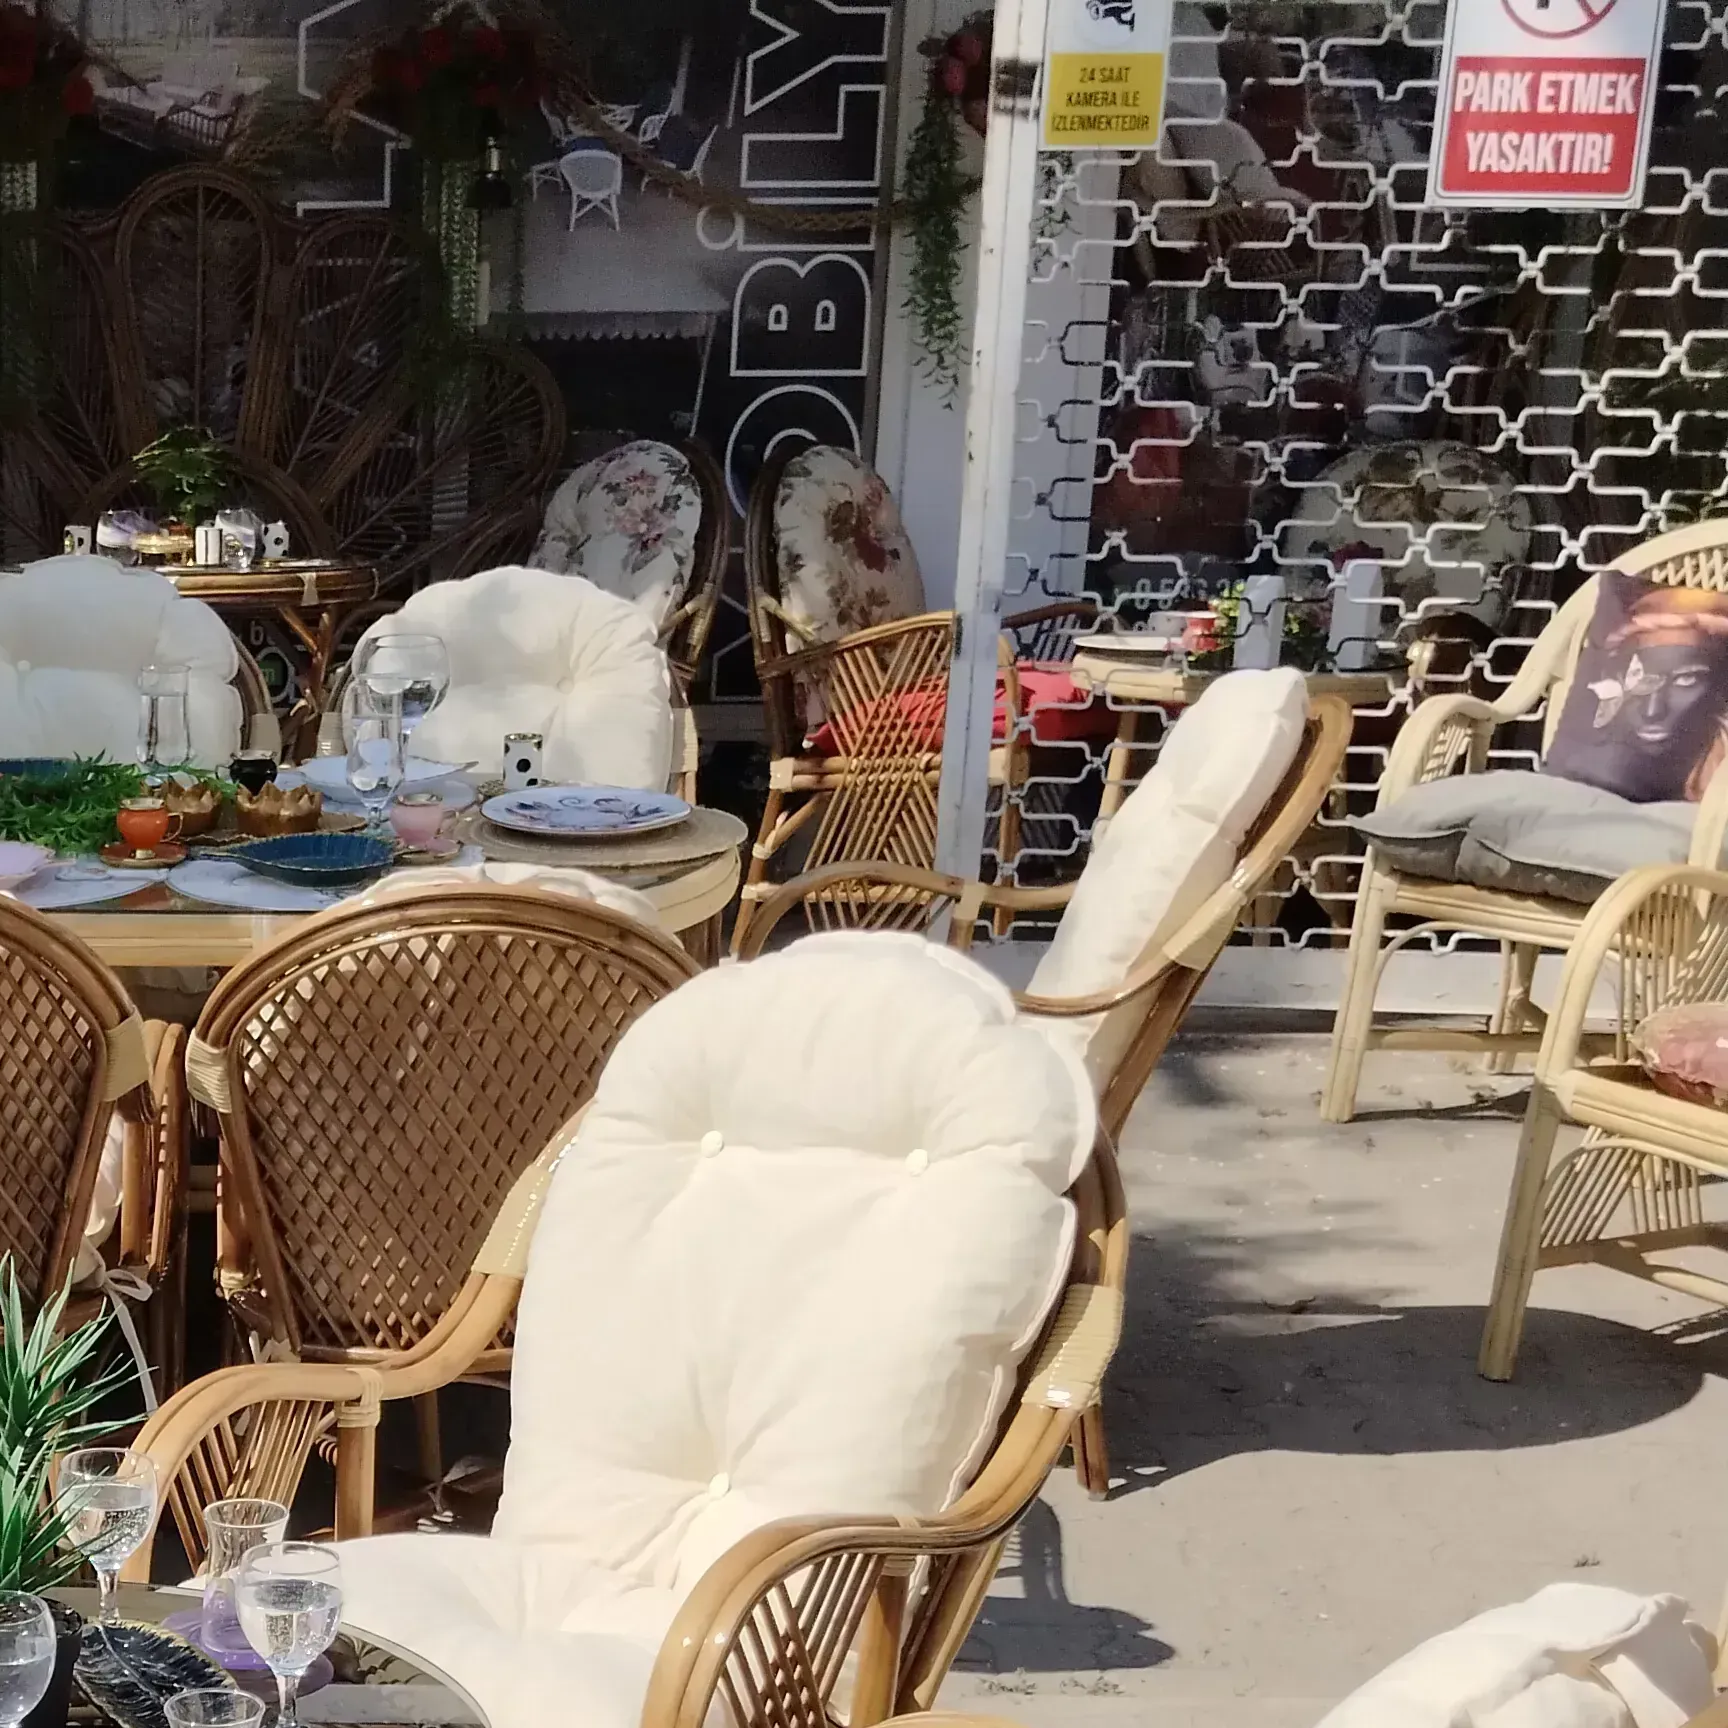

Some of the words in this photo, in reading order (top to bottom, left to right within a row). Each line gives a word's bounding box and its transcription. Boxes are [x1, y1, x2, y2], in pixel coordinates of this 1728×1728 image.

[1079, 66, 1096, 83] 24
[1098, 66, 1131, 83] SAAT
[1065, 90, 1117, 108] KAMERA
[1453, 71, 1535, 113] PARK
[1536, 72, 1640, 115] ETMEK
[1051, 113, 1150, 132] İZLENMEKTEDİR
[1465, 131, 1615, 174] YASAKTIR!
